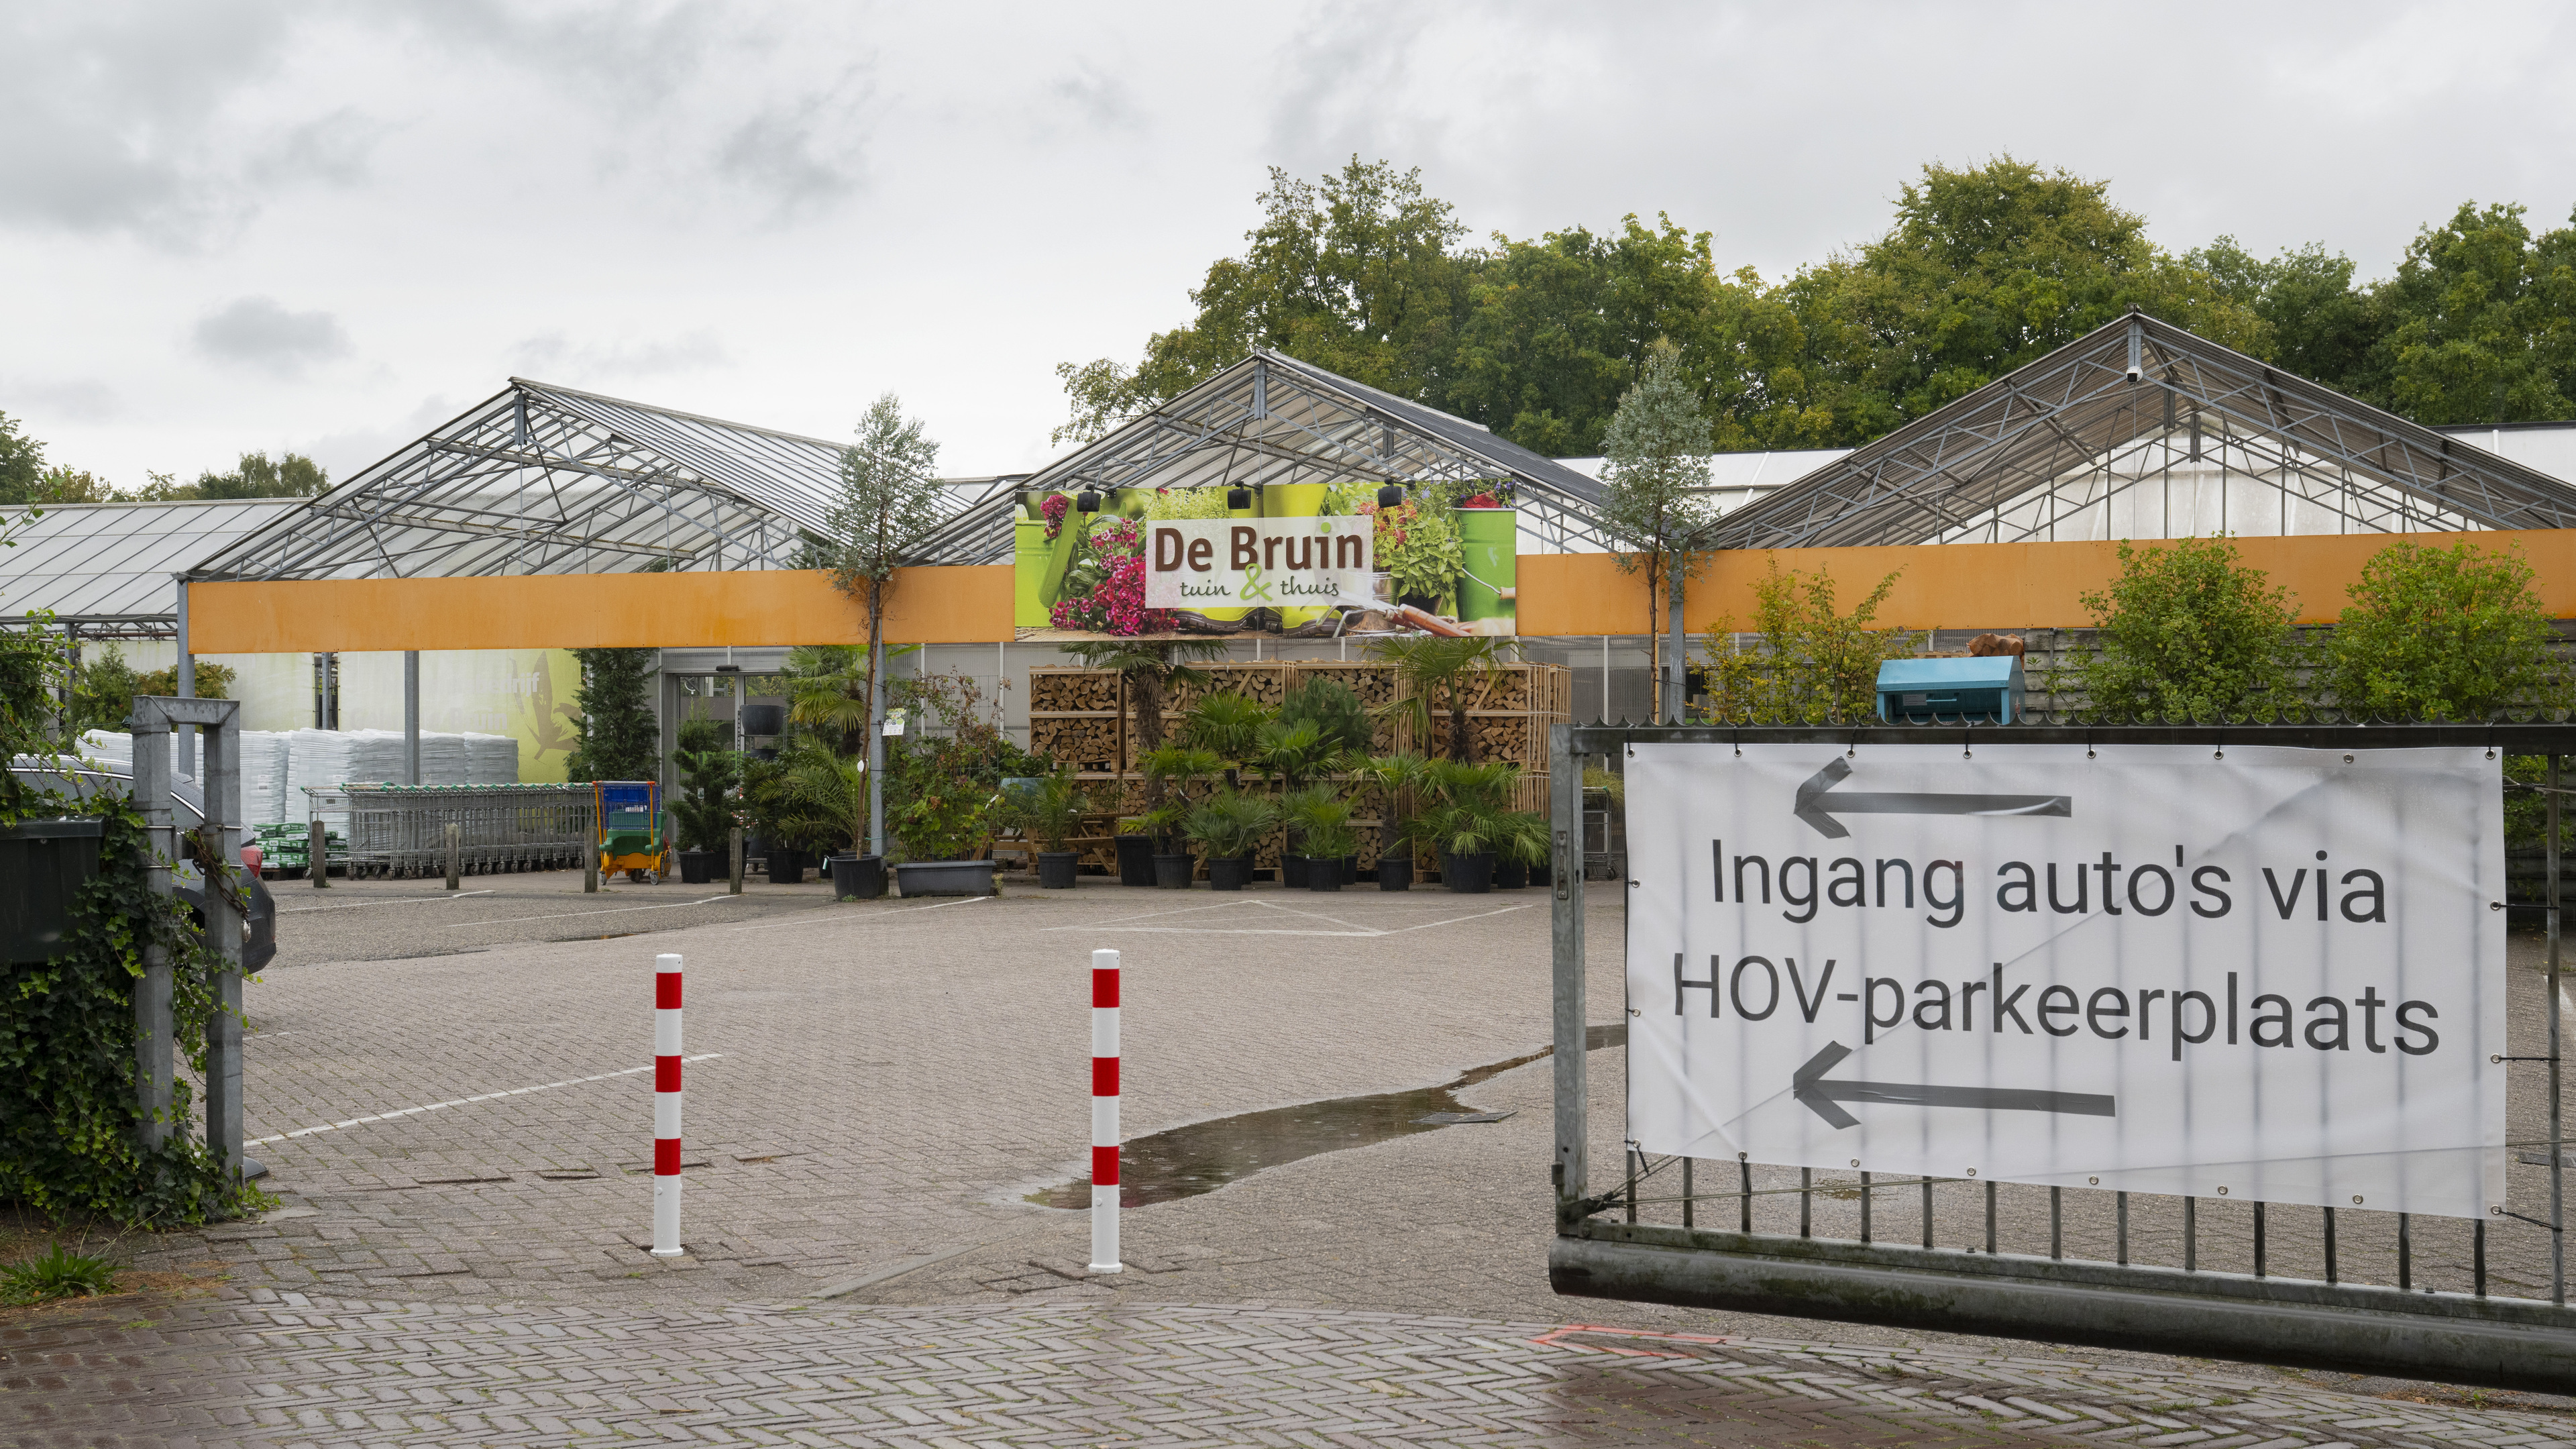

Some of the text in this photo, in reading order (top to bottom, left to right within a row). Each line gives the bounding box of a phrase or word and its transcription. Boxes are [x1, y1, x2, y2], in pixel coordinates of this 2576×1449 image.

[1155, 522, 1363, 572] De Bruin
[1180, 563, 1340, 601] tuin & thuis
[1712, 839, 2387, 928] Ingang auto's via
[1674, 953, 2440, 1062] HOV-parkeerplaats
